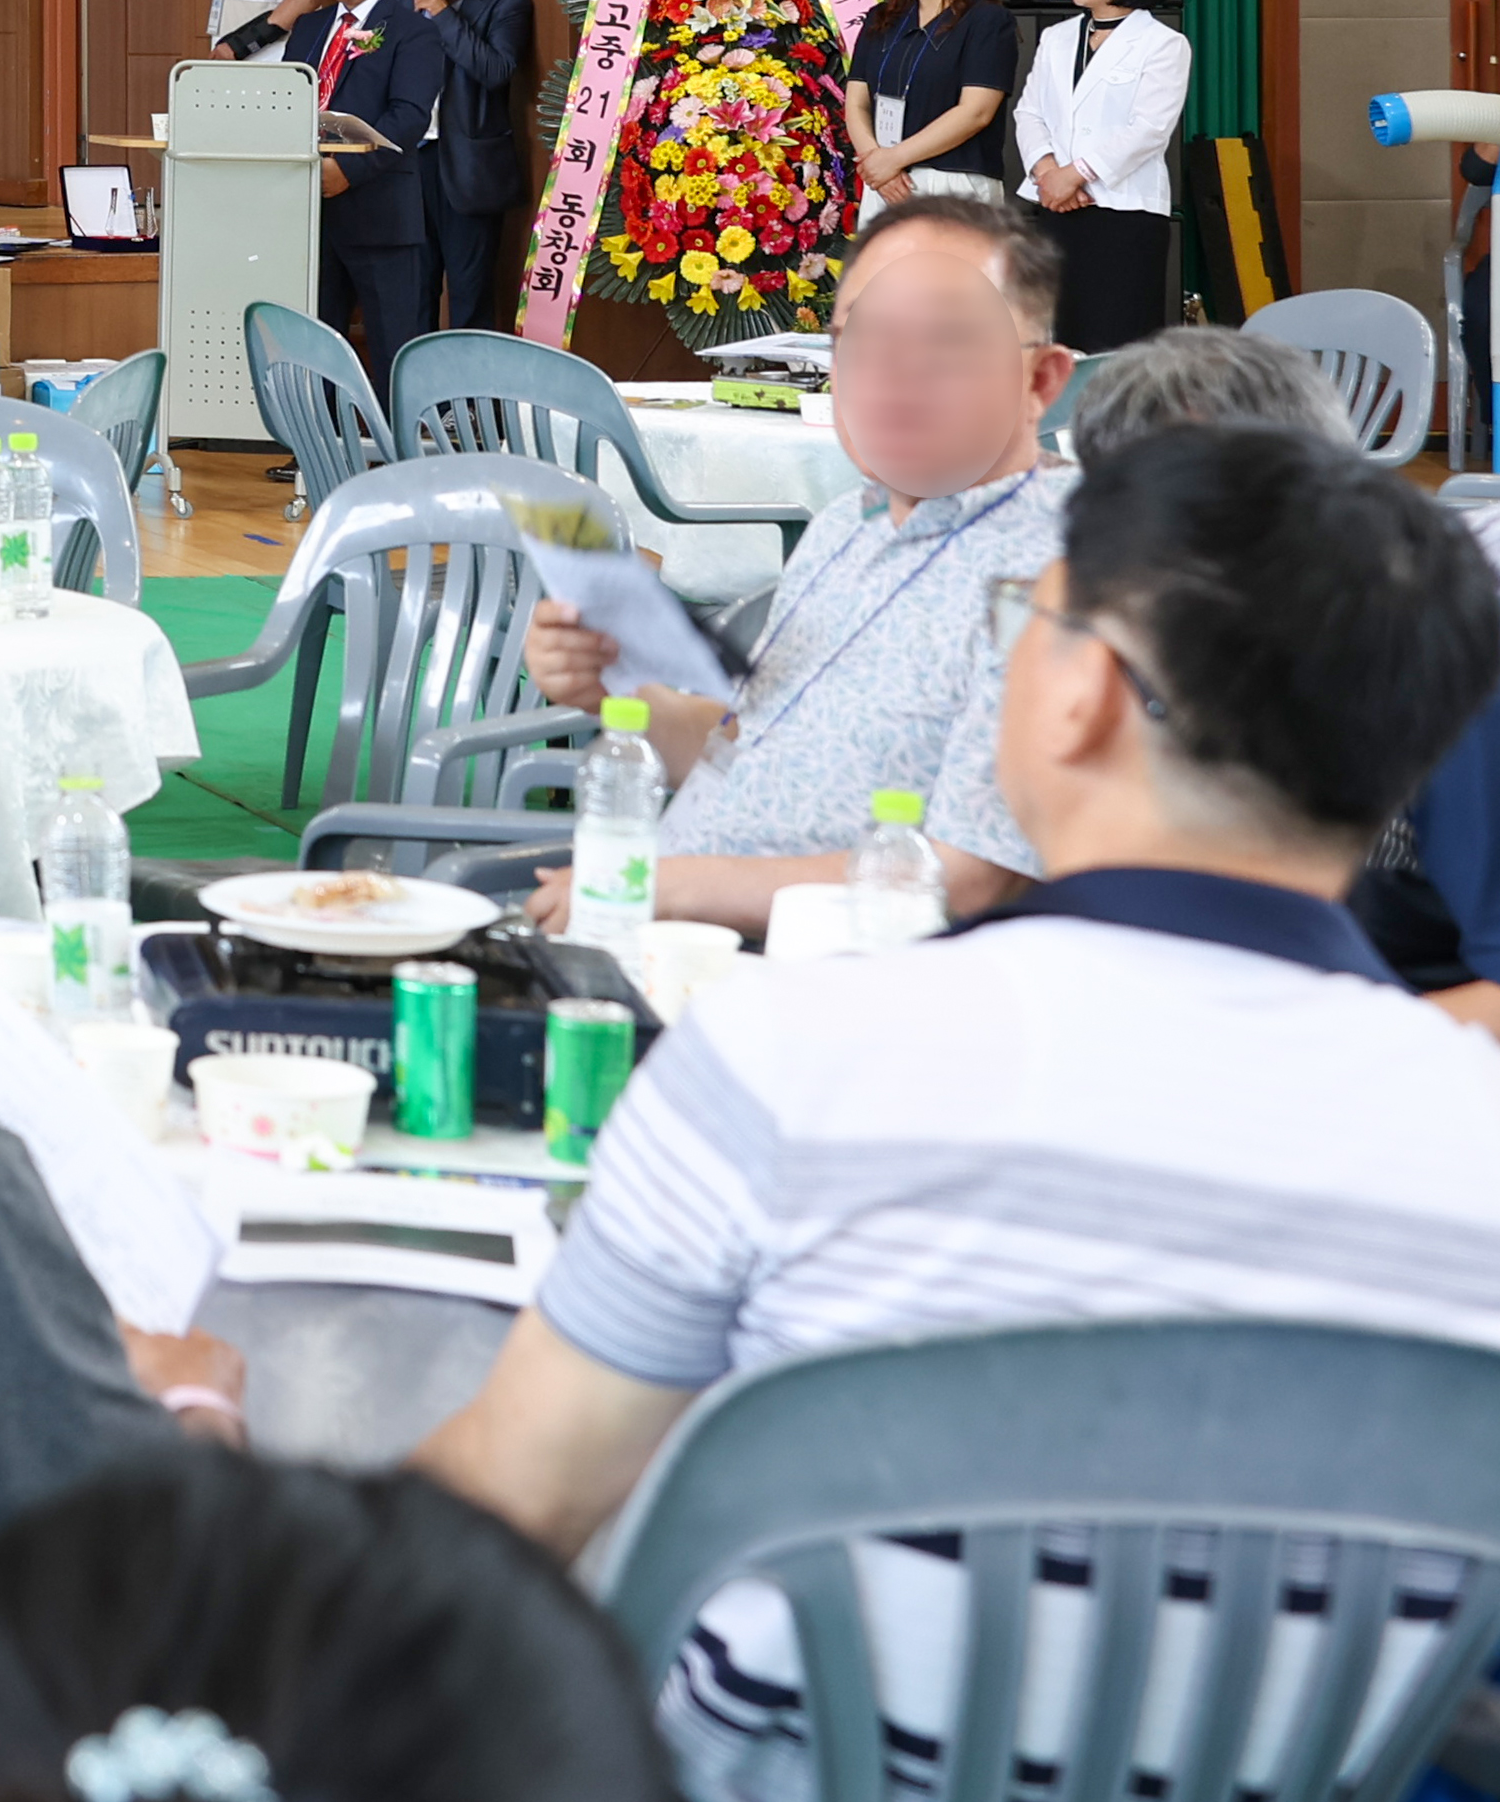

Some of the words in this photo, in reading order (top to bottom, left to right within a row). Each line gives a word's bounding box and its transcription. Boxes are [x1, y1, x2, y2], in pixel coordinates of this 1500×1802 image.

[588, 1, 631, 71] 고중
[578, 85, 610, 118] 21
[531, 191, 587, 299] 동창회
